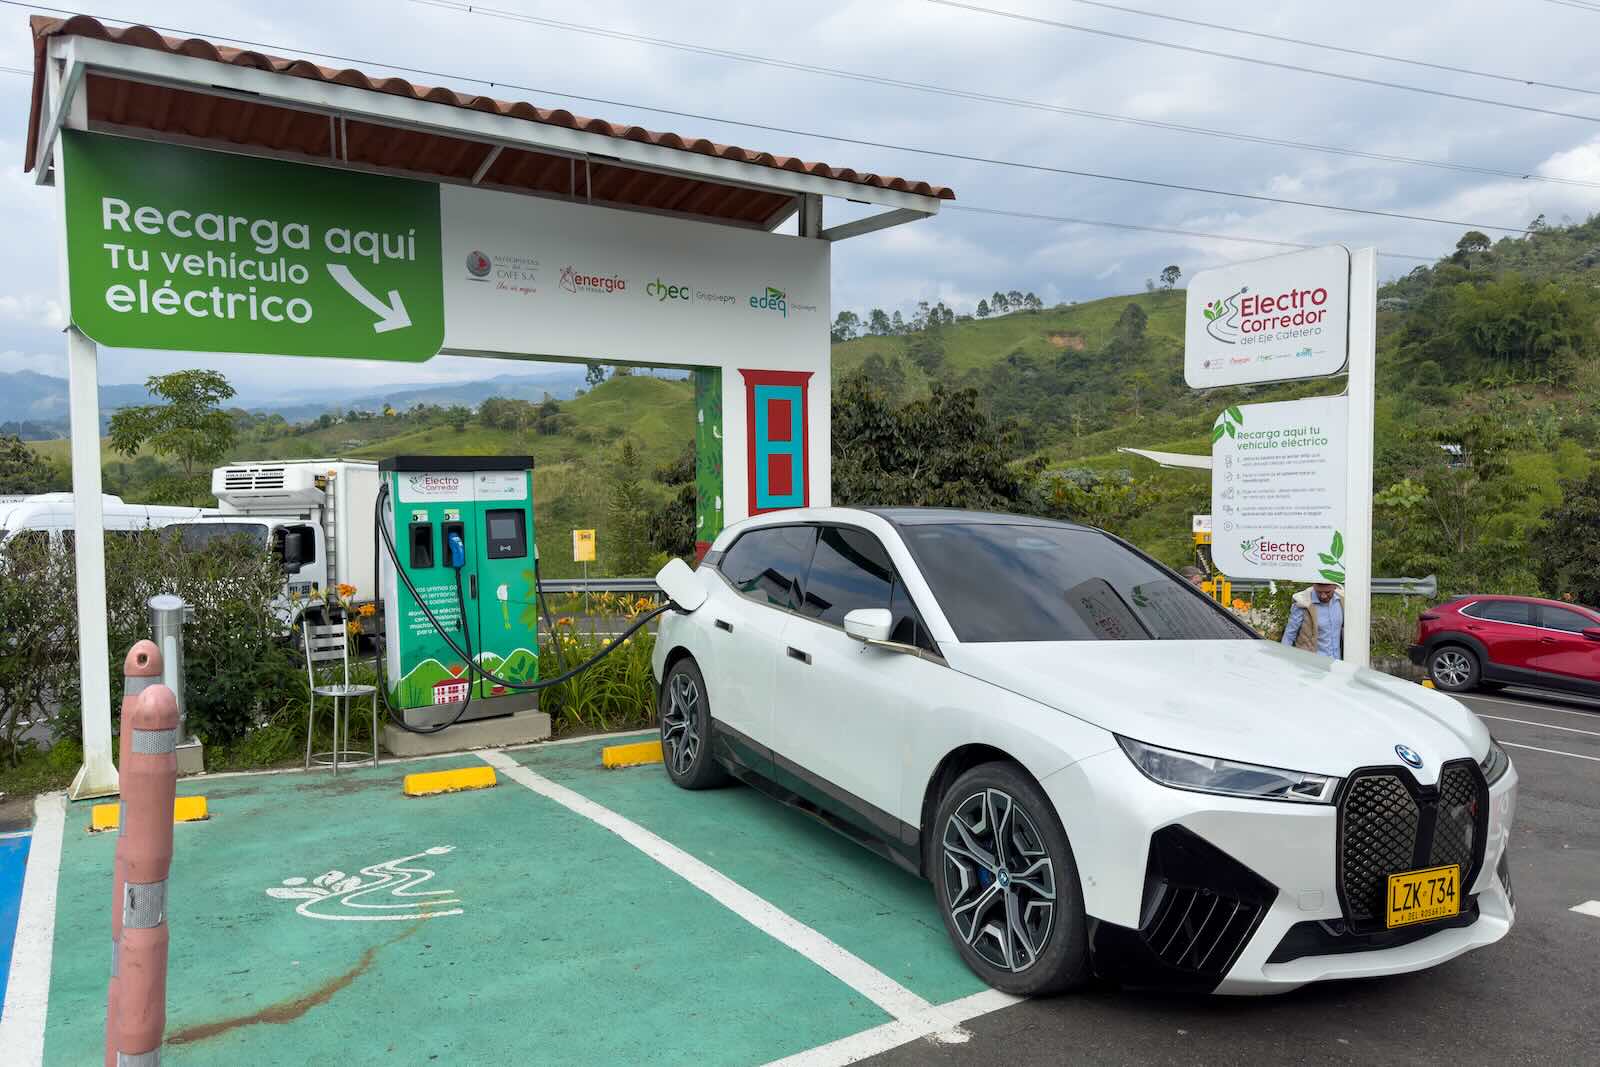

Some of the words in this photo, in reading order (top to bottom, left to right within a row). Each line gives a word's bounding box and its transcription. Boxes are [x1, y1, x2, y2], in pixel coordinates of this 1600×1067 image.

[102, 197, 310, 254] Recarga
[324, 227, 416, 264] aquí
[103, 243, 150, 271] Tu
[160, 250, 310, 285] vehículo
[574, 274, 626, 293] energía
[646, 278, 689, 301] chec
[104, 278, 313, 324] eléctrico
[750, 287, 786, 318] edeq
[1241, 288, 1328, 317] Electro
[1237, 429, 1280, 440] Recarga
[1283, 426, 1307, 440] aquí
[1309, 426, 1320, 435] tu
[1237, 440, 1279, 450] vehículo
[1281, 437, 1328, 448] eléctrico
[425, 477, 459, 485] Electro
[1260, 541, 1305, 553] Electro
[1428, 876, 1456, 906] 734
